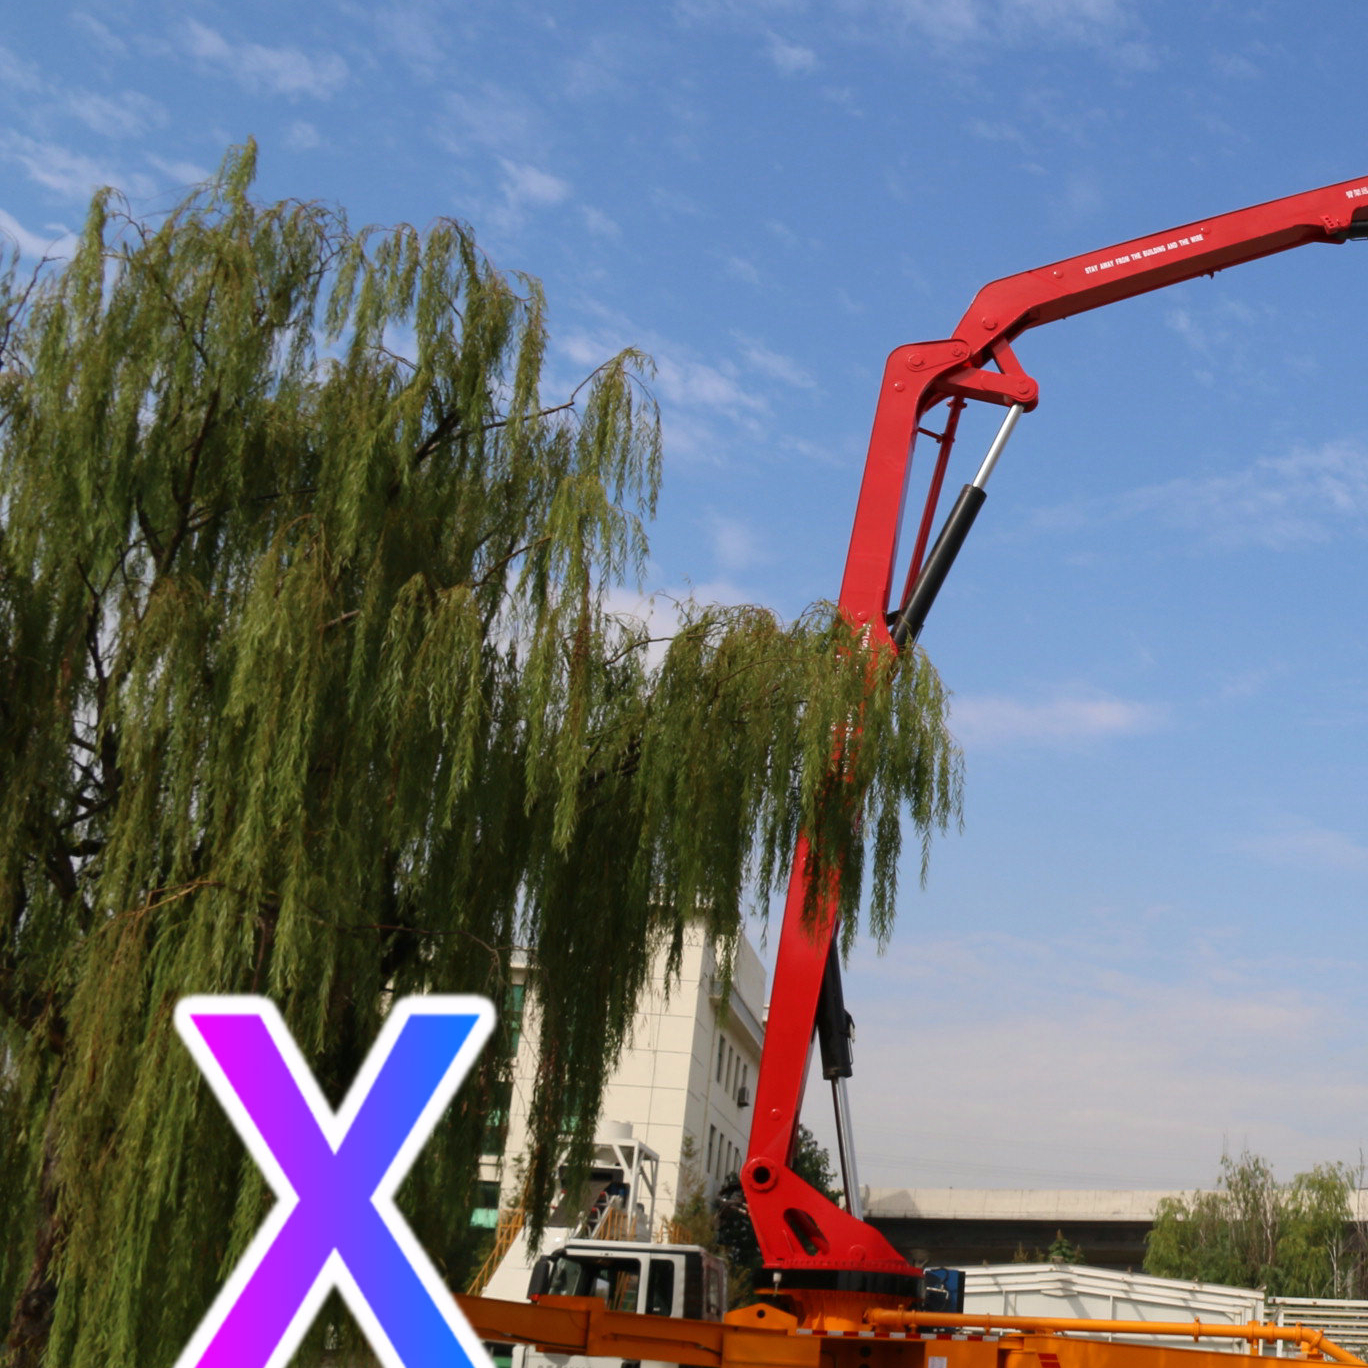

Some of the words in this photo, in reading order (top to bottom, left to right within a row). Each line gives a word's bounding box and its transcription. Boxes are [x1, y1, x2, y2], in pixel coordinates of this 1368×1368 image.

[1085, 265, 1098, 274] STAY
[1100, 260, 1115, 269] AWAY
[1115, 256, 1131, 265] FROM
[1131, 252, 1142, 260] THE
[1143, 245, 1166, 257] BUILDING
[1167, 242, 1178, 250] AND
[1179, 238, 1189, 246] THE
[1191, 234, 1203, 243] WIRE
